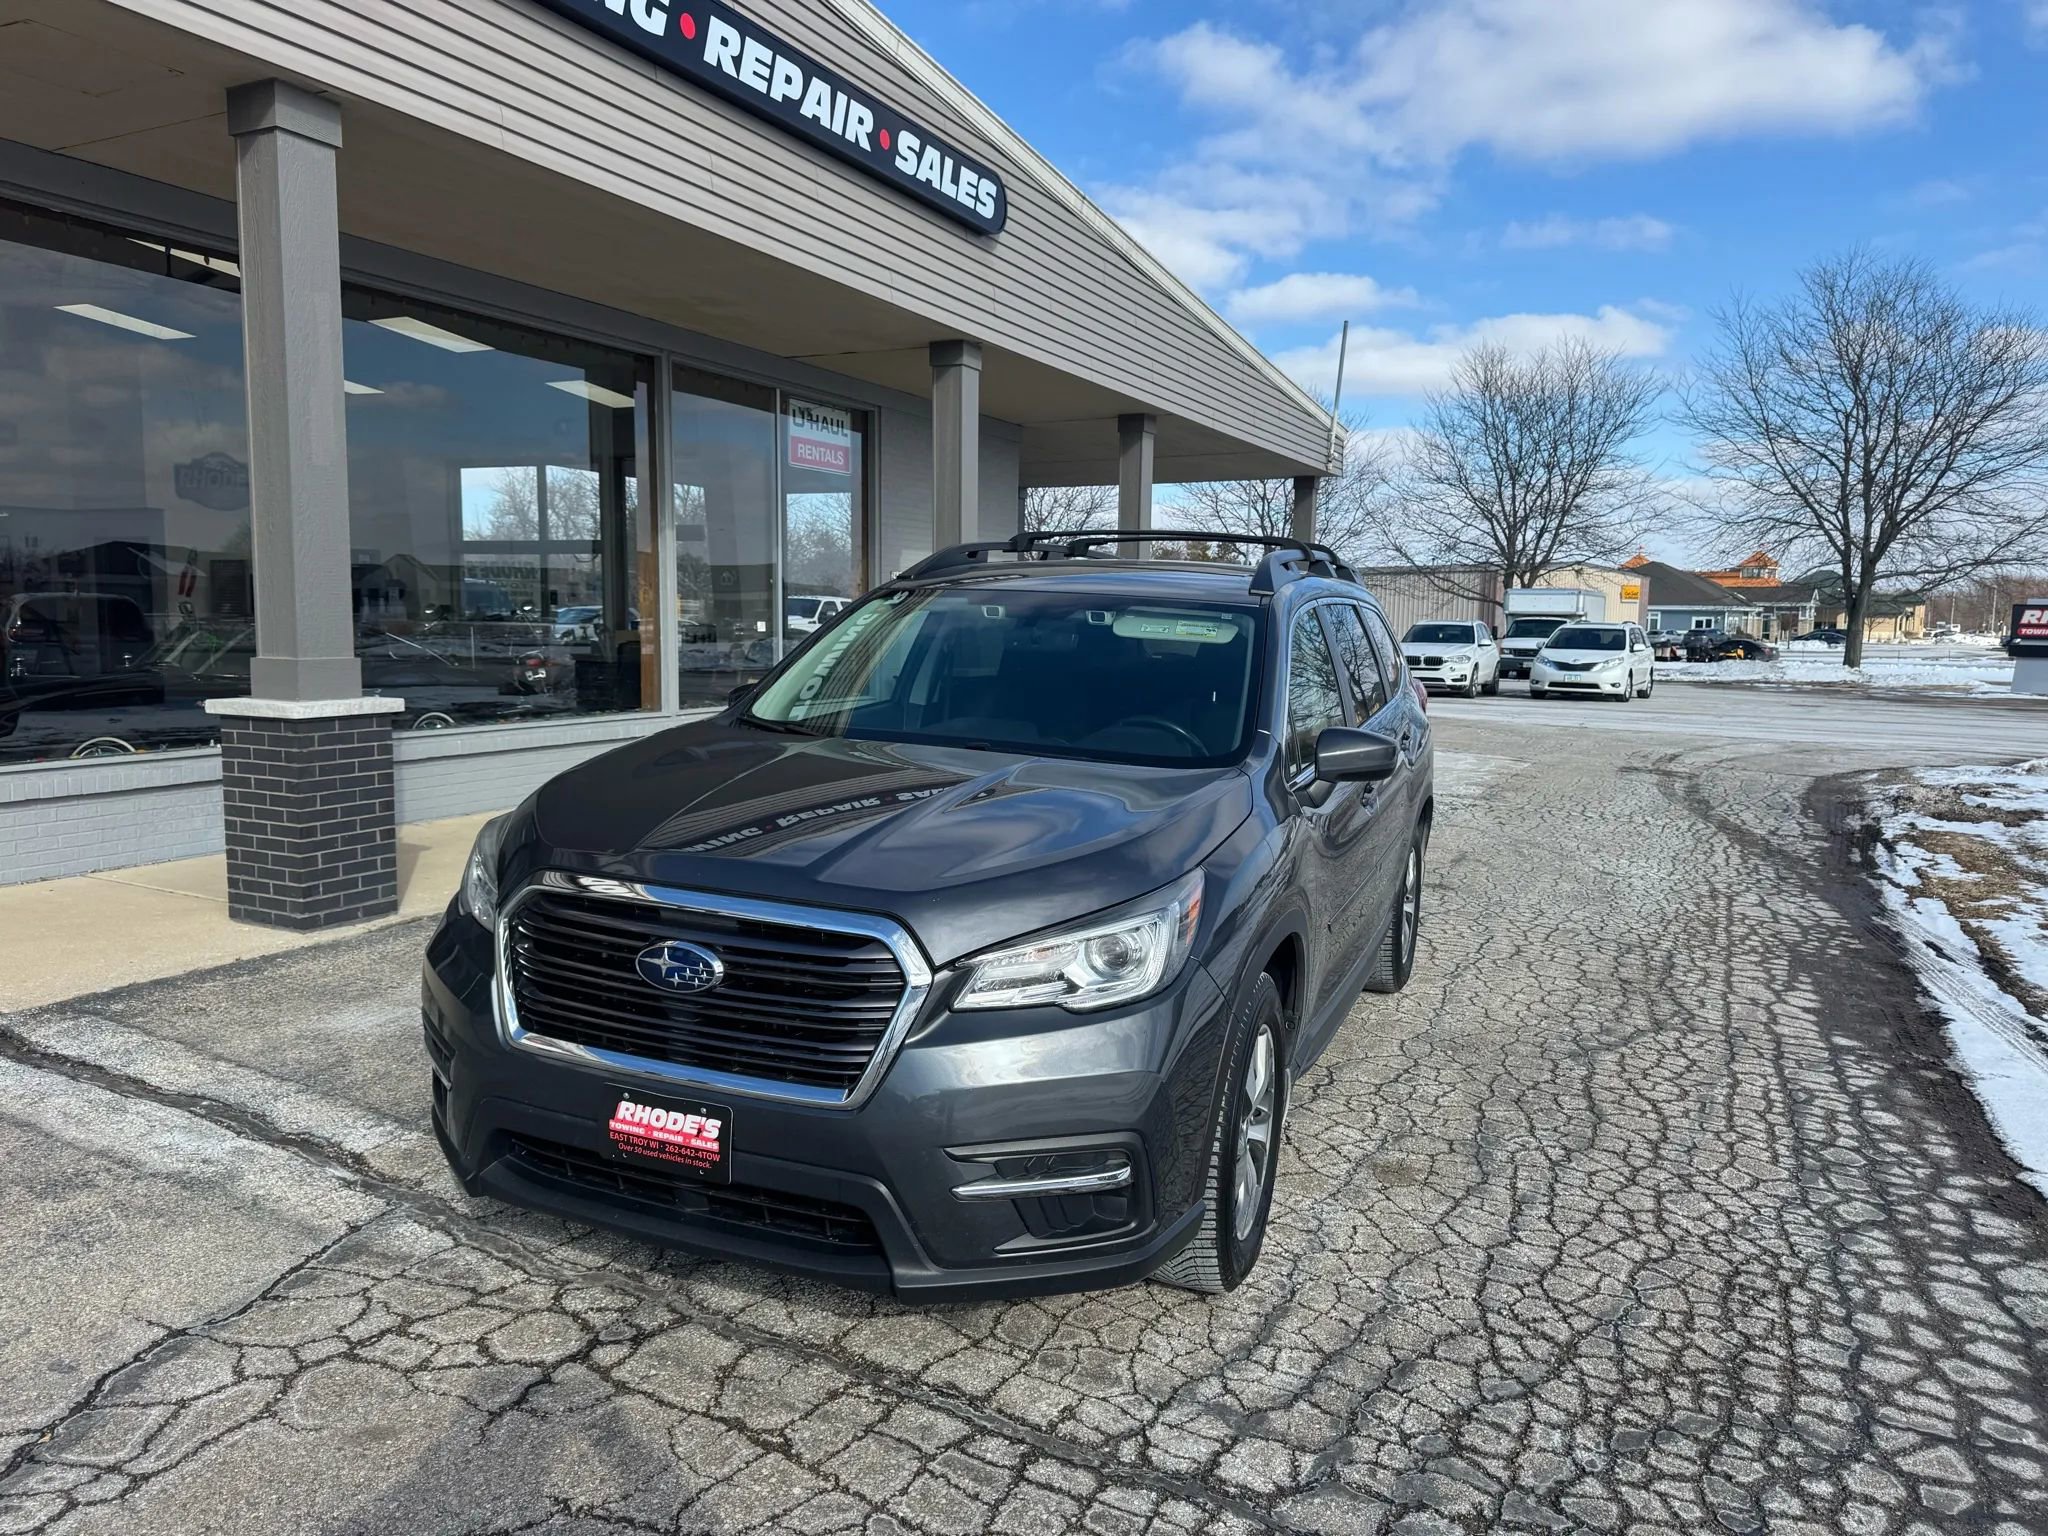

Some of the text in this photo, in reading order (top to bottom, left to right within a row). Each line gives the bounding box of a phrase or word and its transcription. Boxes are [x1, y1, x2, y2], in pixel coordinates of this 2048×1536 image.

[703, 15, 874, 153] REPAIR
[895, 130, 998, 220] SALES
[798, 443, 844, 465] RENTALS
[614, 1100, 722, 1140] RHODE'S
[610, 1121, 719, 1150] TOWING REPAIR SALES
[610, 1132, 720, 1162] EAST TROY WI 262-642-4TOW
[618, 1142, 633, 1152] Over
[643, 1149, 658, 1158] used
[659, 1152, 684, 1164] vehicles
[685, 1157, 692, 1165] in
[693, 1159, 712, 1168] stock.
